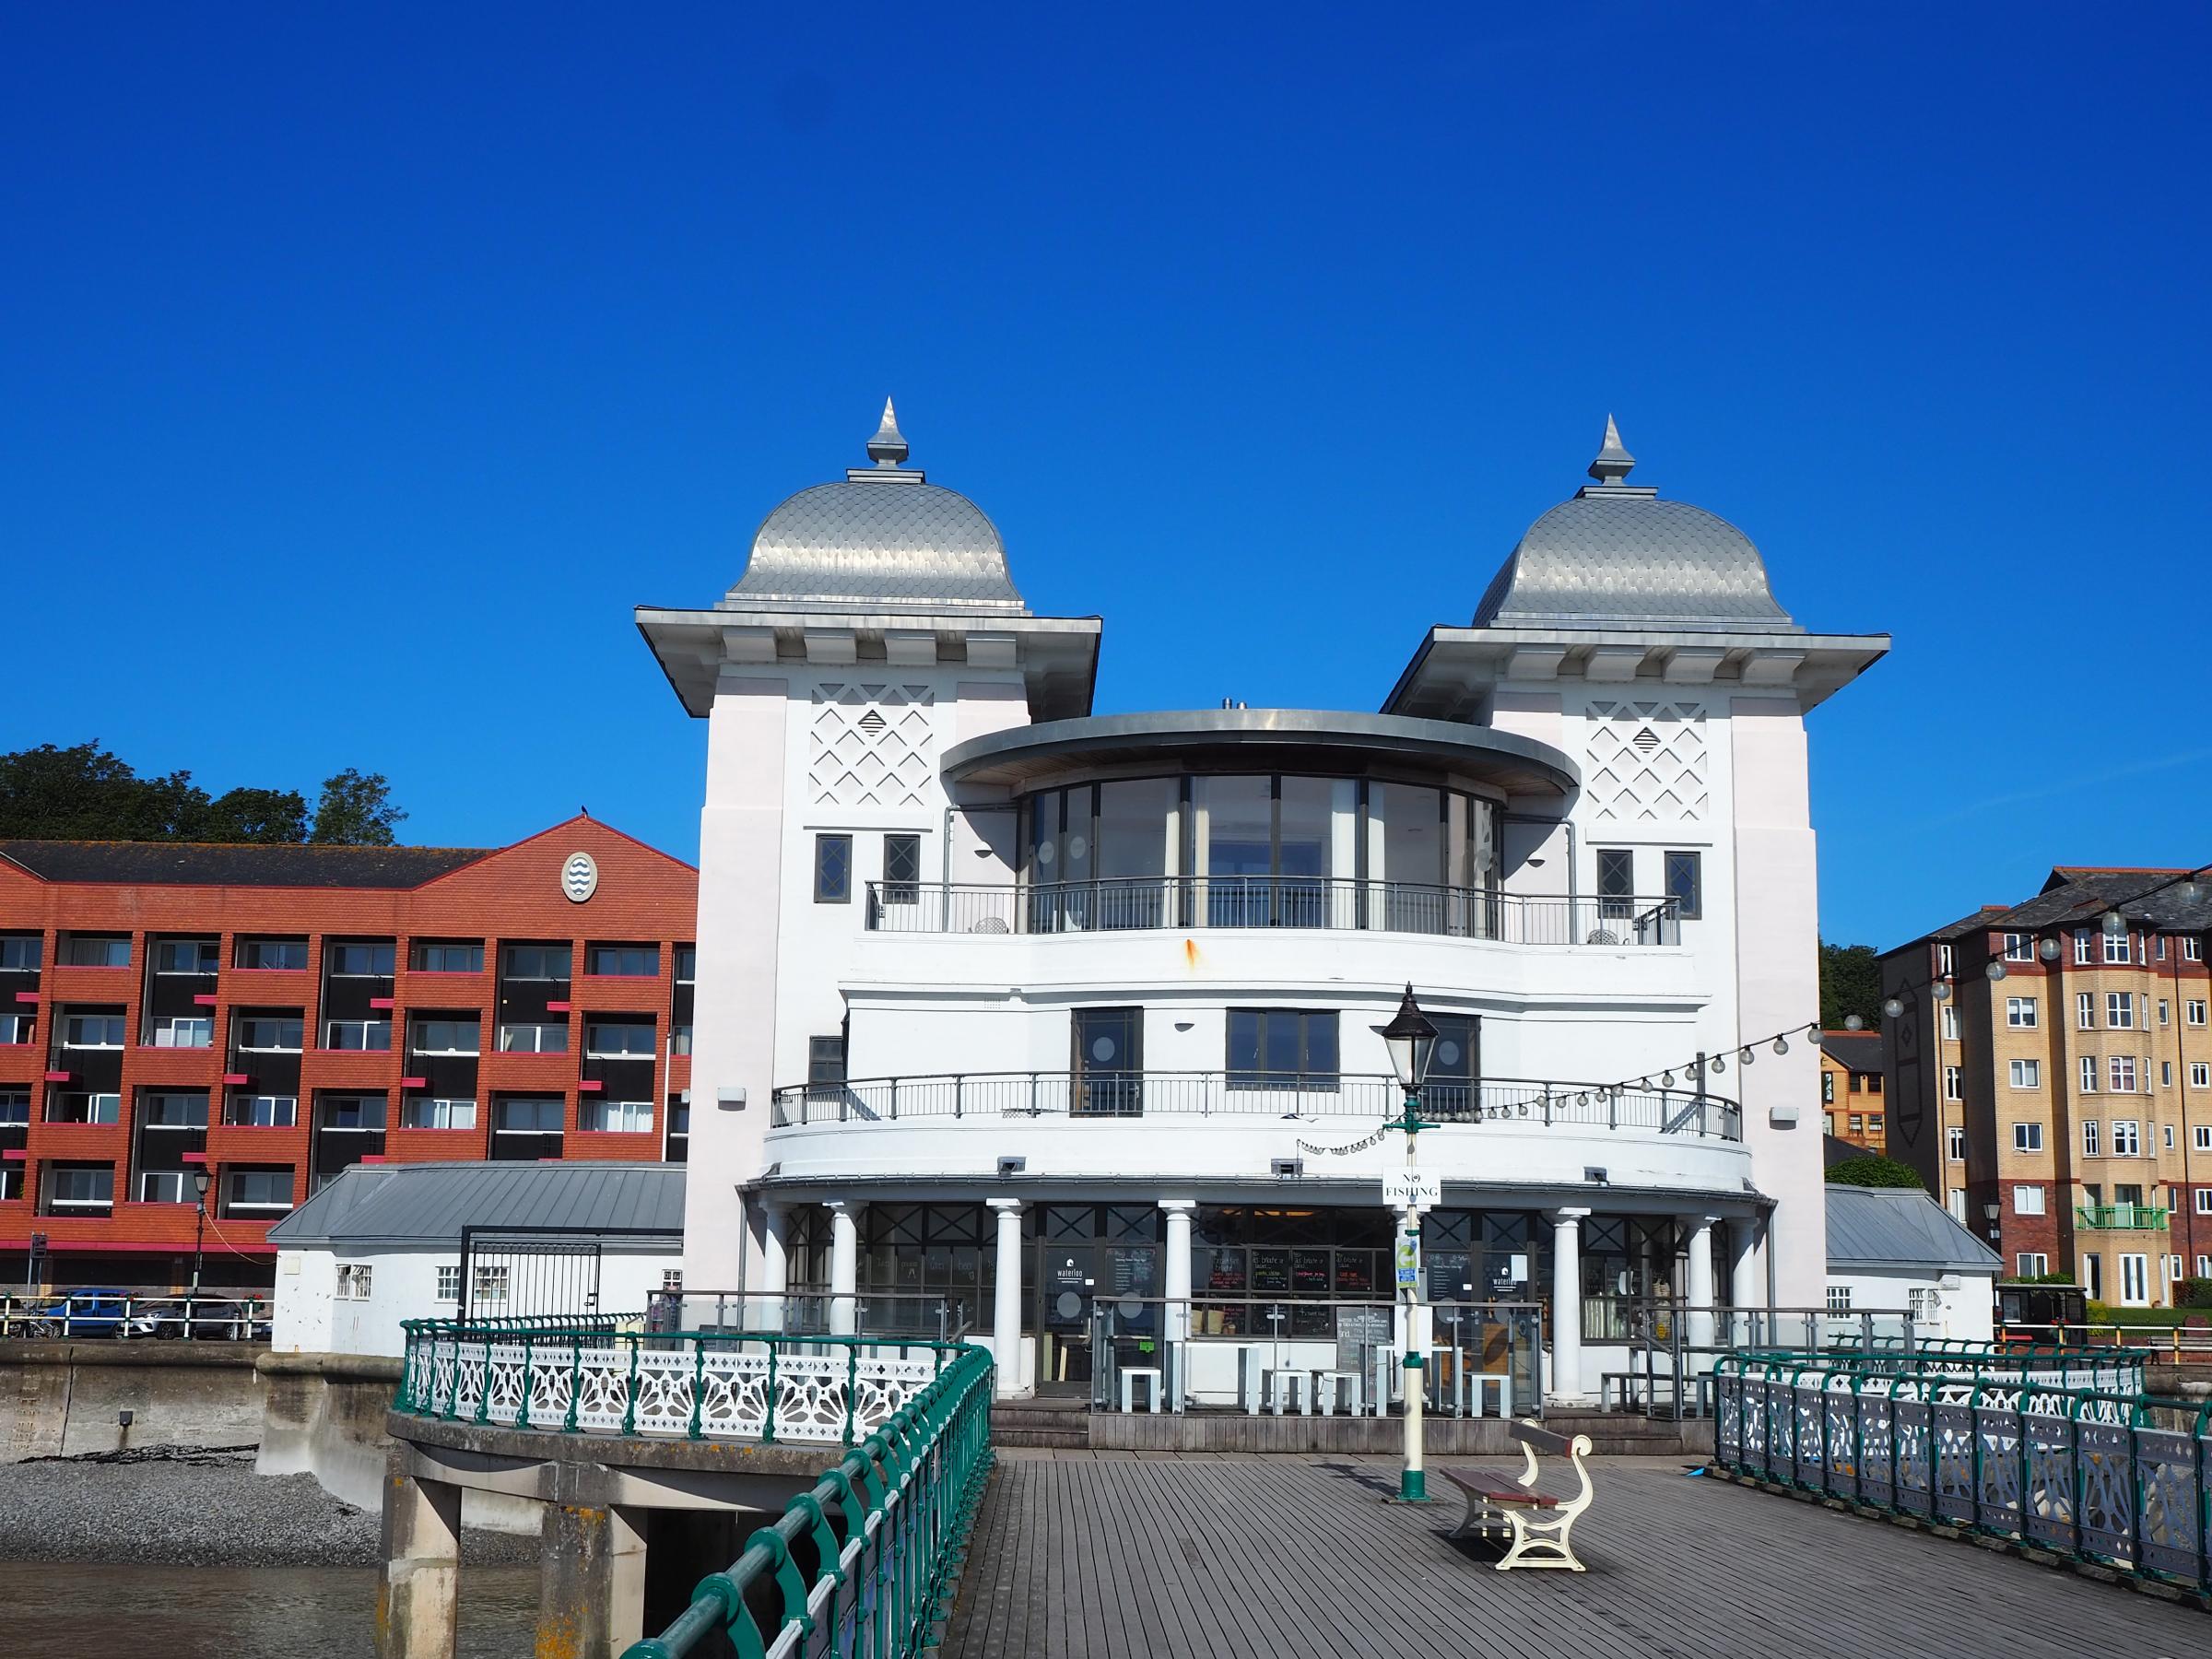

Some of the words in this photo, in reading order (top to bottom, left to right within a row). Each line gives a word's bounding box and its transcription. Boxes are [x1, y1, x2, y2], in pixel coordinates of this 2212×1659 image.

[1403, 1174, 1421, 1182] NO
[1386, 1187, 1438, 1196] FISHING
[1057, 1269, 1083, 1277] waterloo
